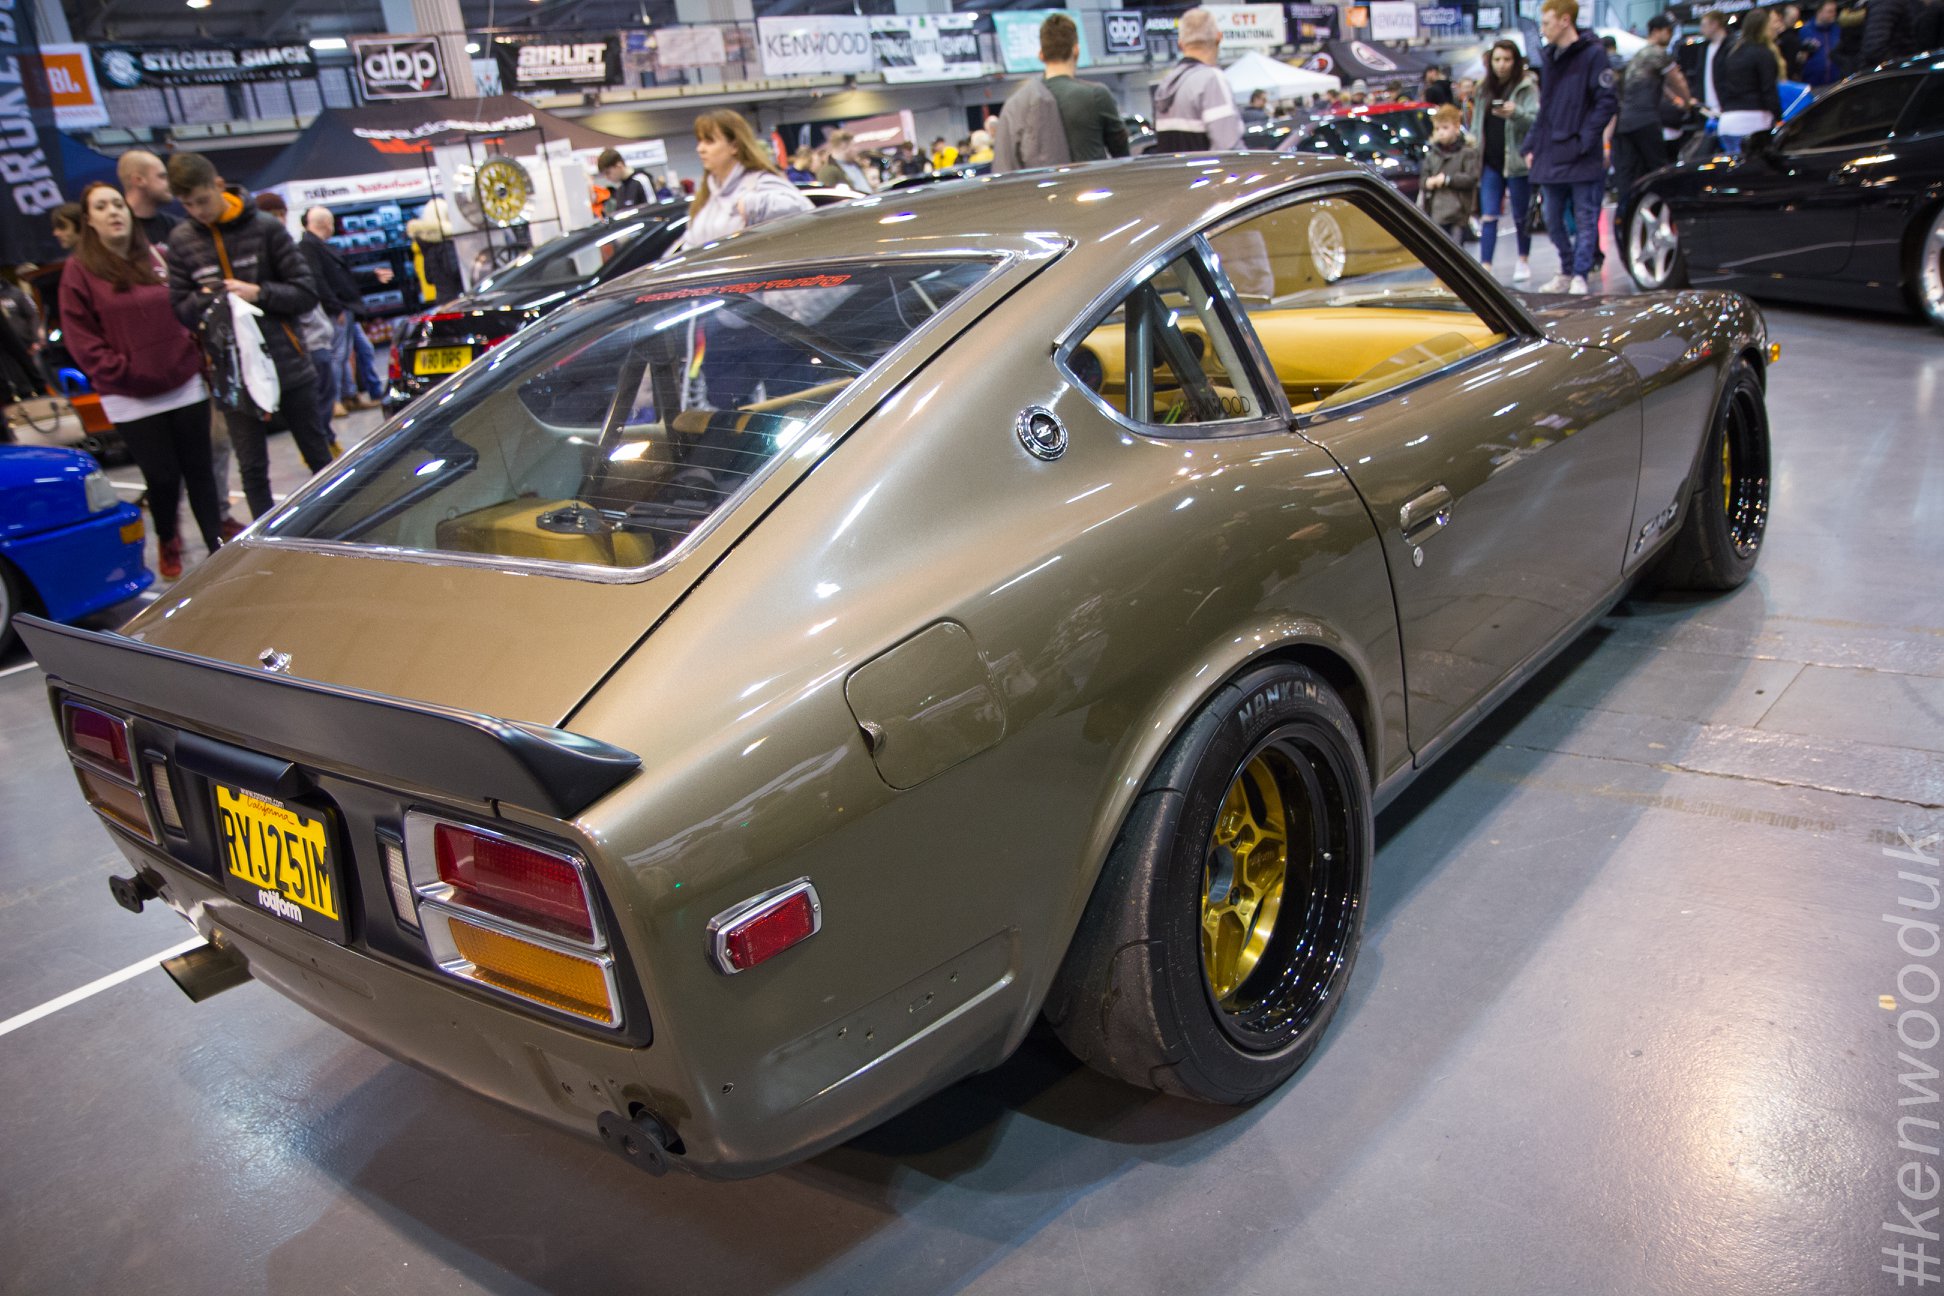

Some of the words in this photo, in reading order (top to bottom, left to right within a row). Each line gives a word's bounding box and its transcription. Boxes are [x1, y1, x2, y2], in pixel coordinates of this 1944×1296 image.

[141, 50, 237, 71] STICKER
[240, 46, 312, 67] SHACK
[765, 32, 868, 58] KENWOOD
[364, 45, 437, 83] abp
[46, 66, 82, 94] BL
[258, 889, 303, 923] rotiform
